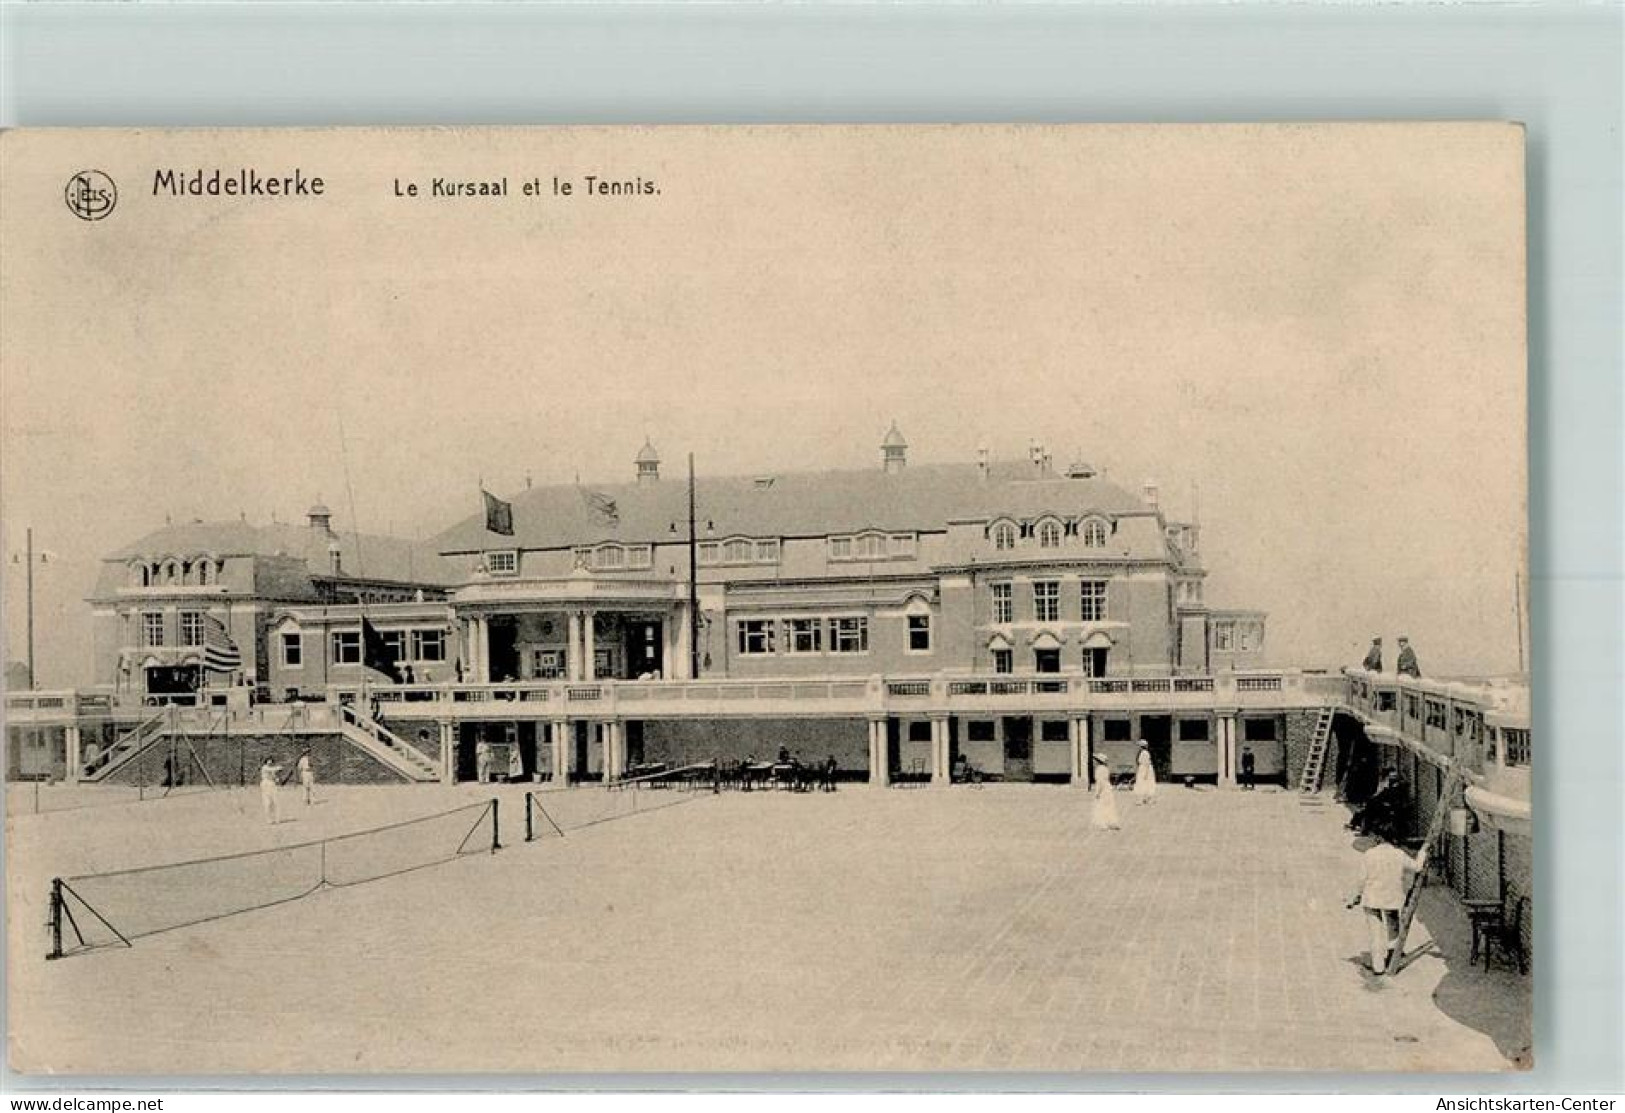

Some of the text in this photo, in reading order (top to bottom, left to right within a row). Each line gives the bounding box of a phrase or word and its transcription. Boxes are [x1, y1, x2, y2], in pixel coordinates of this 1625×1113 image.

[152, 168, 325, 197] Middelkerke
[394, 176, 662, 197] Le Kursaal et le Tennis.
